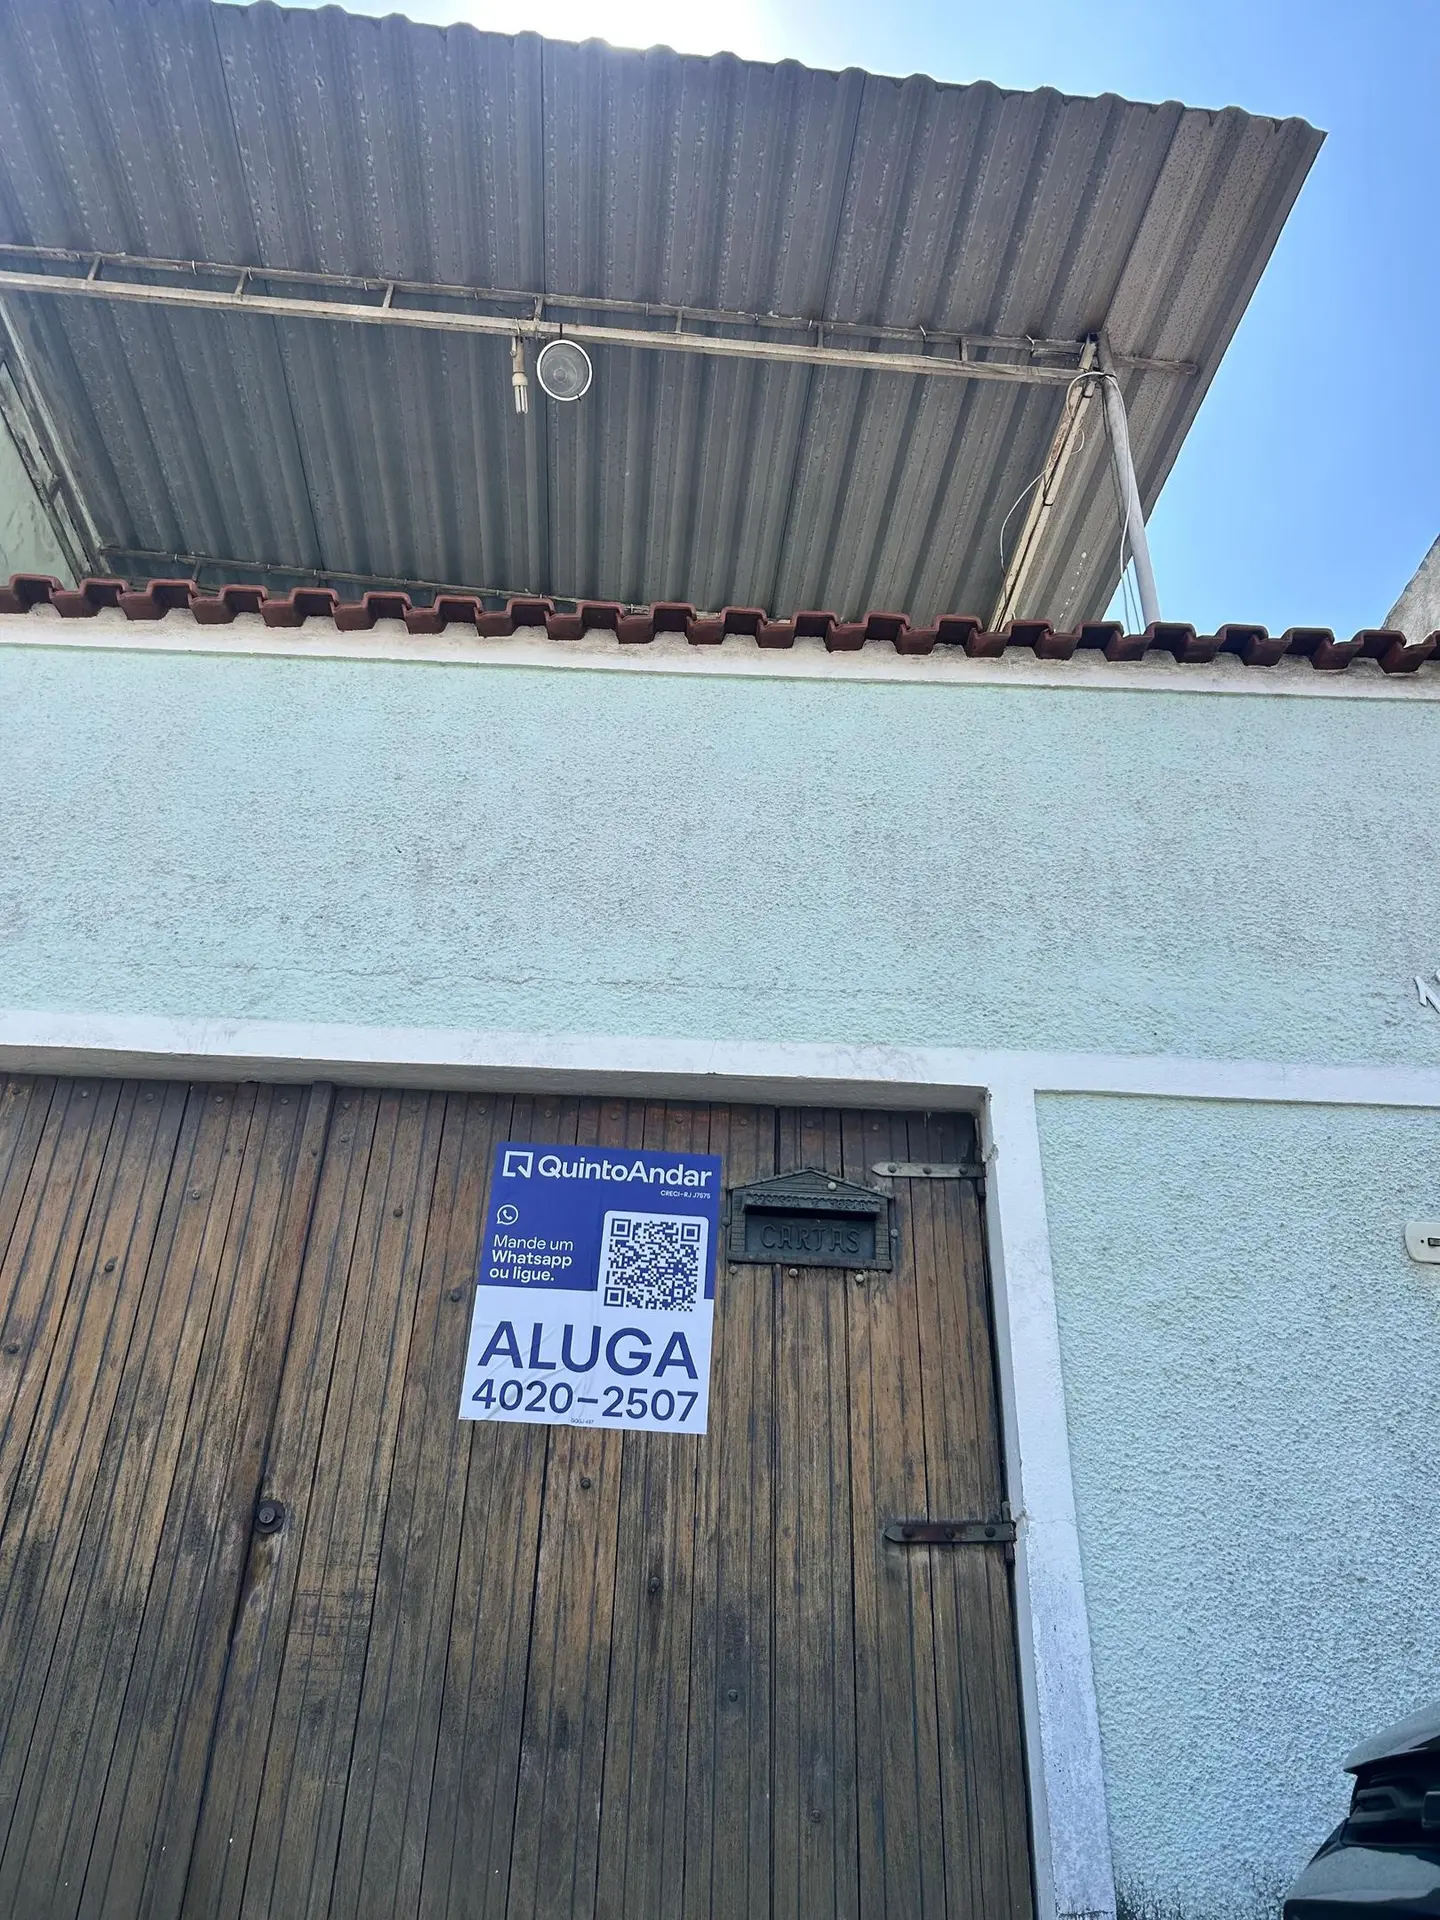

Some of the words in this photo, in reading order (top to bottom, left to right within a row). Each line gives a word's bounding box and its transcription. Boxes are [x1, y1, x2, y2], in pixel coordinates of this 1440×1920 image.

[538, 1155, 712, 1187] QuintoAndar
[660, 1189, 692, 1198] CRECI-RJ
[493, 1234, 546, 1250] Mande
[549, 1240, 574, 1251] um
[761, 1224, 861, 1254] CARTAS
[492, 1249, 573, 1270] Whatsapp
[489, 1267, 510, 1279] ou
[512, 1266, 555, 1283] ligue.
[477, 1320, 699, 1380] ALUGA
[472, 1379, 699, 1422] 4020-2507
